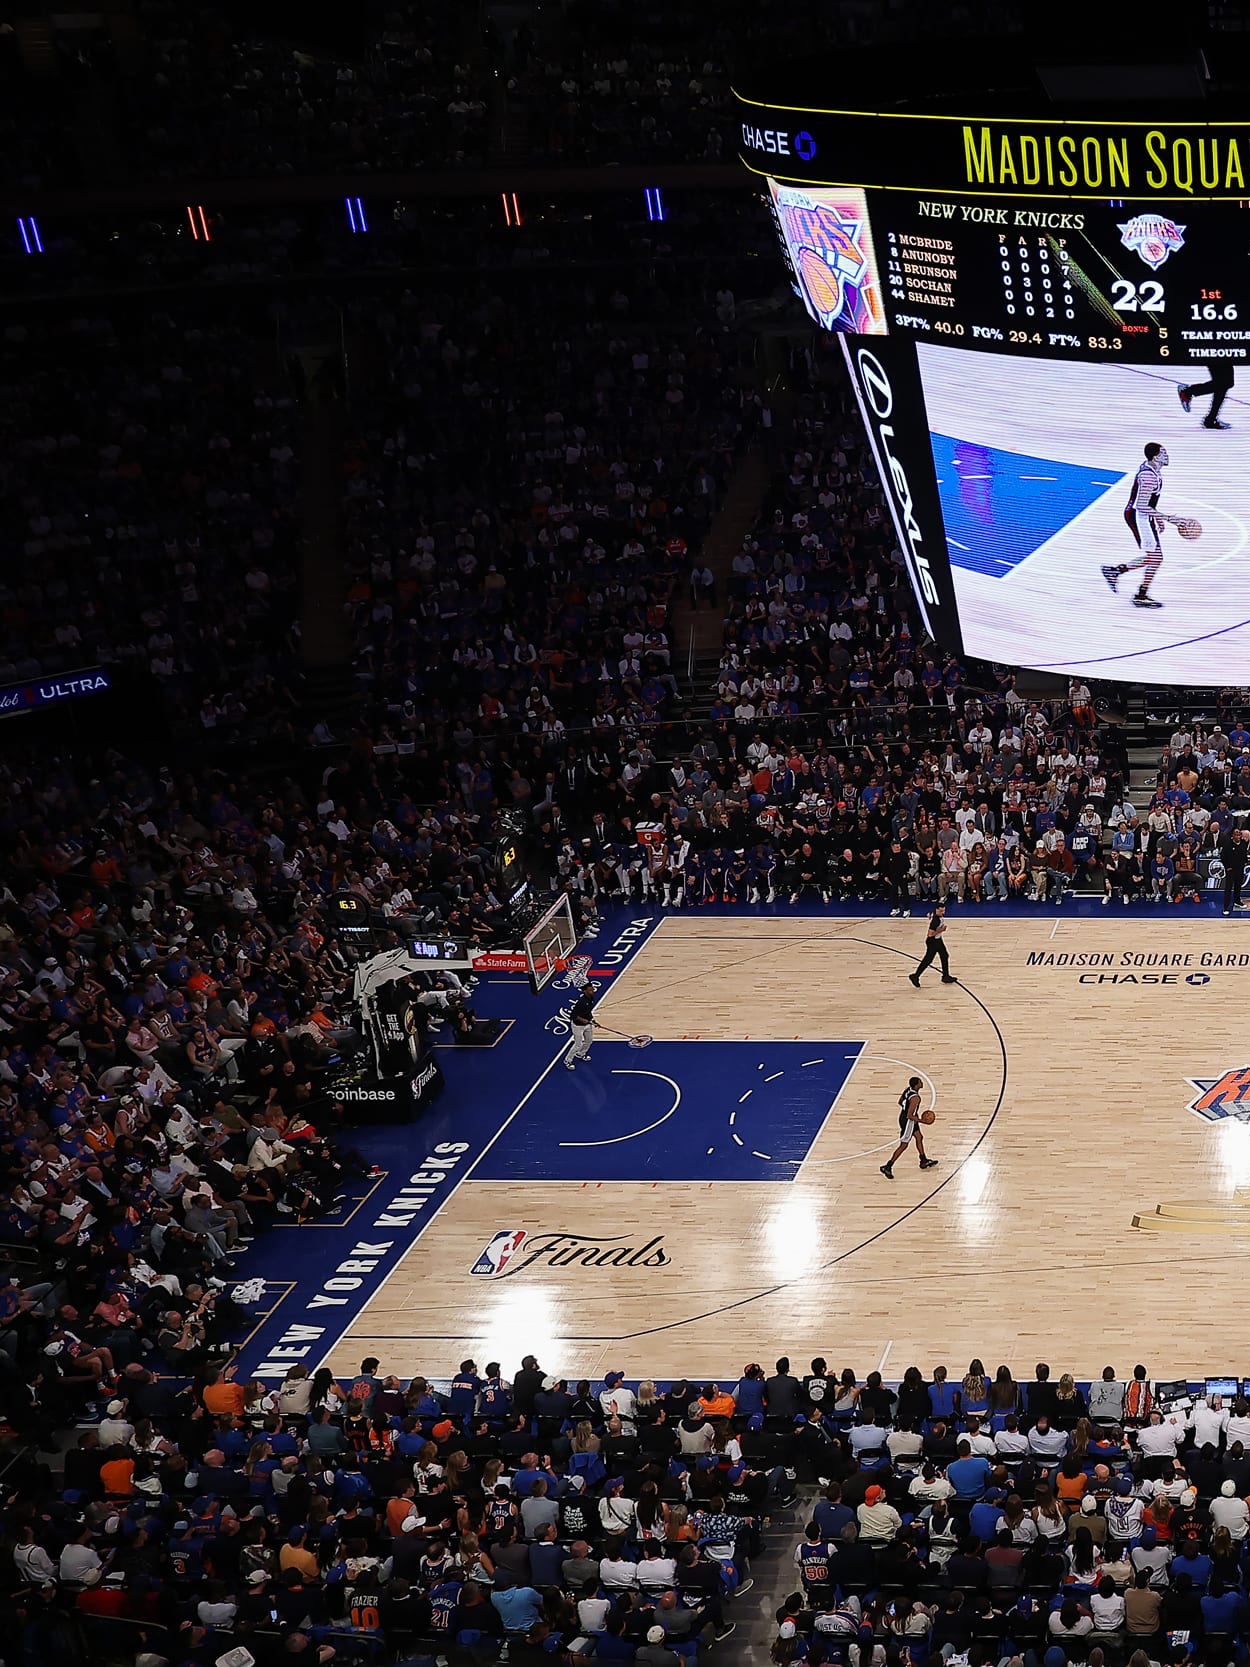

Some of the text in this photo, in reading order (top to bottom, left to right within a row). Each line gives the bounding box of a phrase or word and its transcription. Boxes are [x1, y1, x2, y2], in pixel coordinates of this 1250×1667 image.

[741, 124, 791, 156] CHASE
[962, 126, 1130, 187] MADISON
[918, 201, 1085, 230] NEW YORK KNICKS
[998, 234, 1067, 248] F A R P
[1122, 220, 1182, 241] KNICKS
[888, 233, 1069, 261] 2 MCBRIDE 0 0 0 0
[891, 247, 1070, 276] 8 ANUNOBY 7
[888, 261, 1072, 291] 11 BRUNSON 3 4
[888, 275, 952, 293] 20 SOCHAN
[891, 289, 1055, 318] 44 SHAMET 2
[1111, 280, 1166, 313] 22
[1201, 288, 1222, 300] 1st
[1190, 304, 1238, 321] 16.6
[895, 314, 1123, 350] 3PT% 40.0 FG% 29.4 FT% 83.3
[1122, 325, 1150, 333] BONUS
[1159, 327, 1168, 339] 5
[1181, 331, 1214, 341] TEAM
[1160, 345, 1170, 357] 6
[1189, 348, 1247, 358] TIMEOUTS
[880, 424, 940, 606] LEXUS
[40, 676, 108, 699] ULTRA
[598, 917, 654, 965] ULTRA
[1025, 951, 1111, 967] MADISON
[1120, 951, 1193, 968] SQUARE
[1078, 973, 1179, 985] CHASE
[252, 1141, 471, 1379] NEW YORK KNICKS
[474, 1232, 672, 1281] NBA Finals
[173, 1558, 187, 1574] 3
[804, 1566, 829, 1581] 50
[351, 1595, 379, 1607] FRAZIER
[351, 1607, 380, 1628] 10
[431, 1608, 449, 1628] 21
